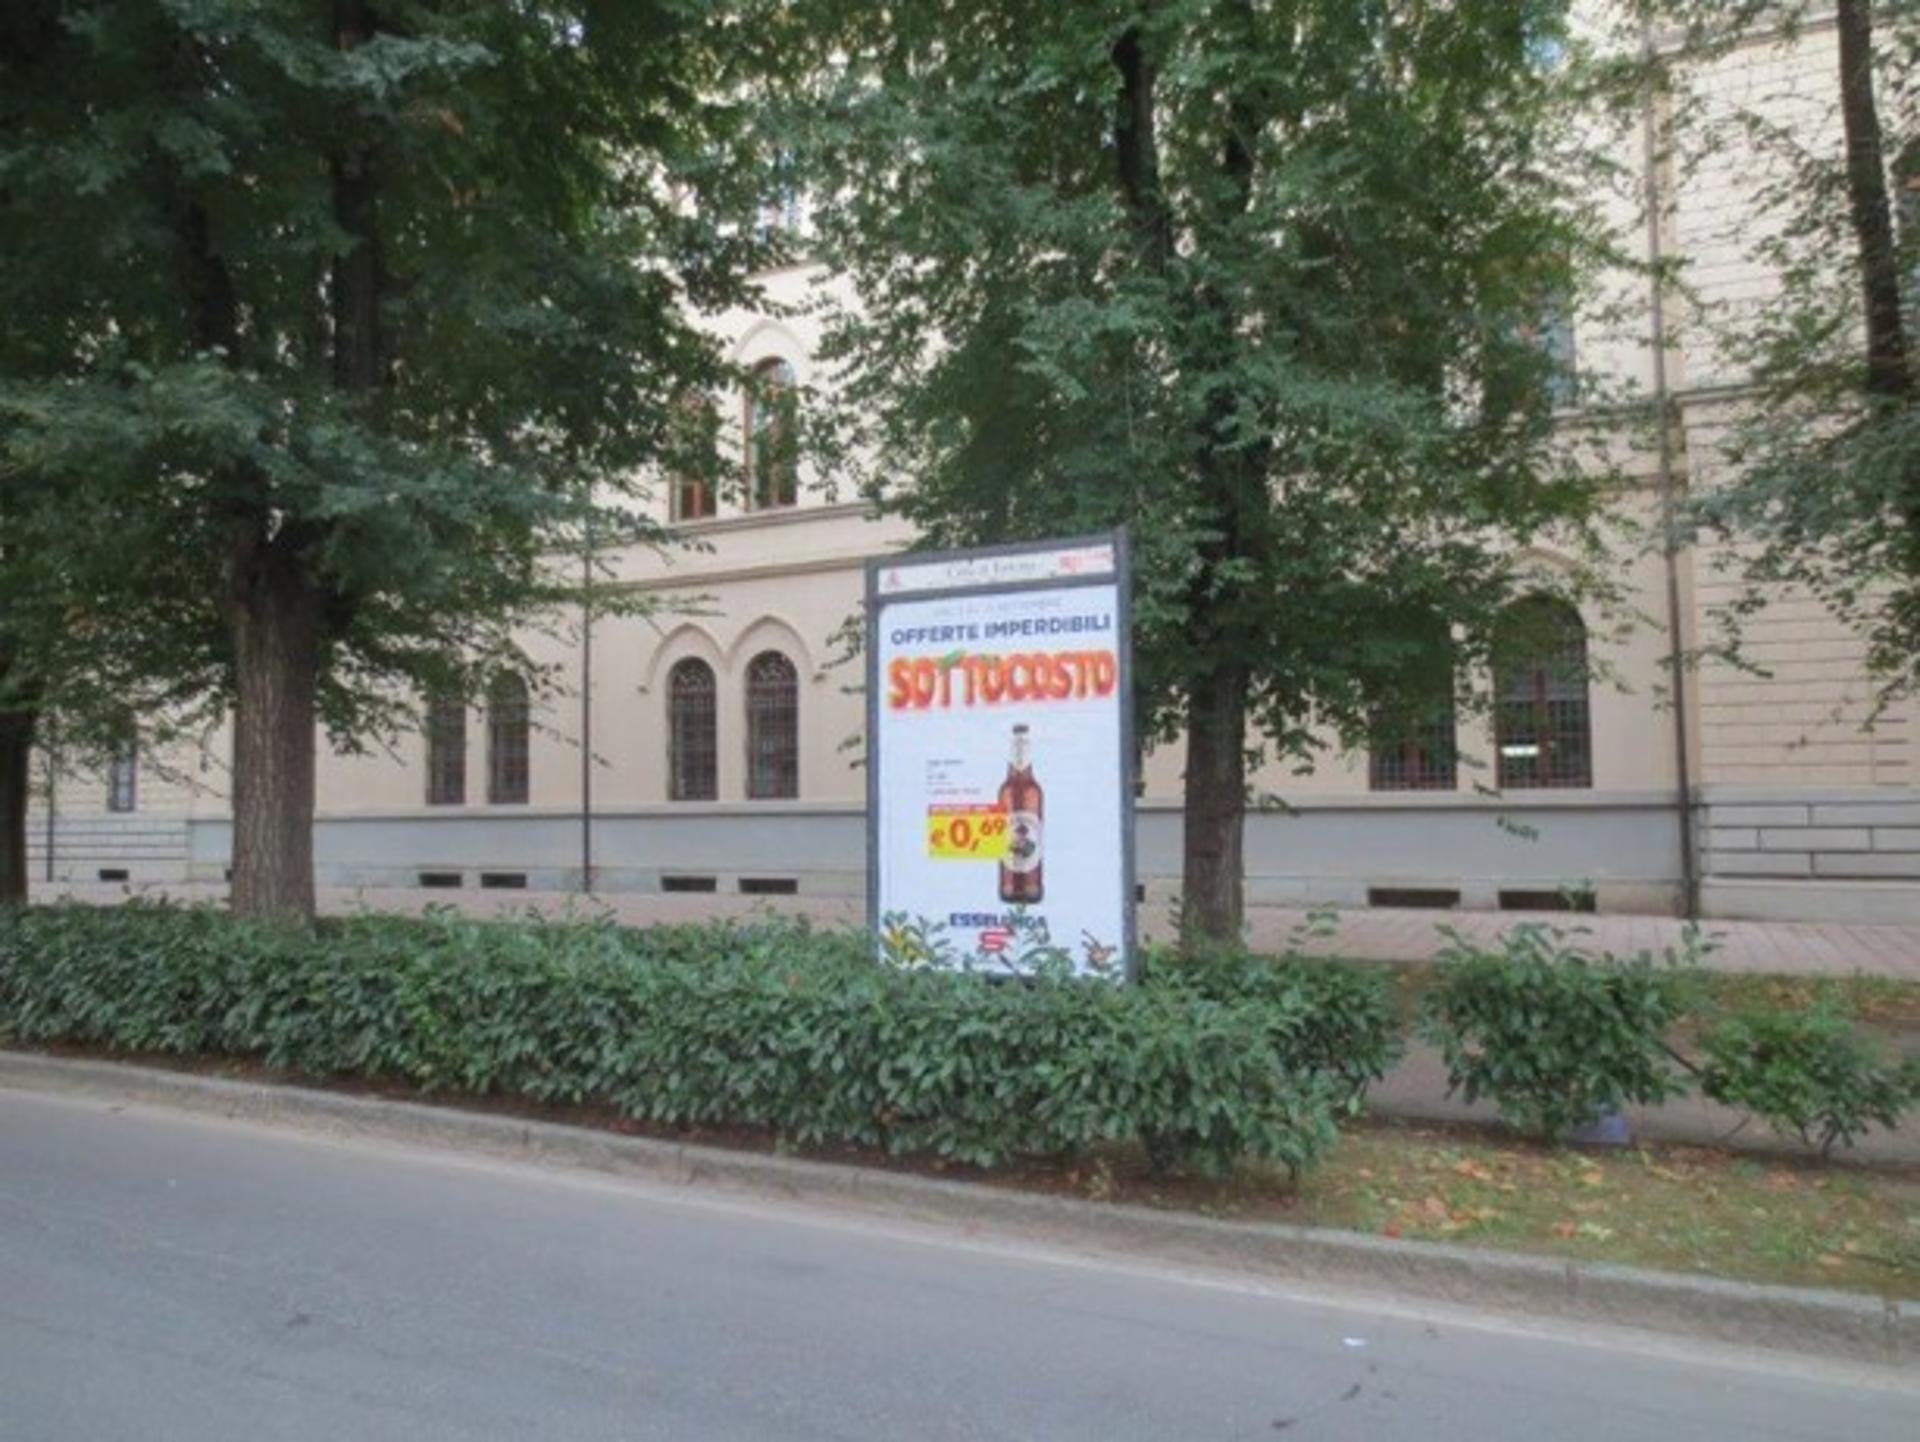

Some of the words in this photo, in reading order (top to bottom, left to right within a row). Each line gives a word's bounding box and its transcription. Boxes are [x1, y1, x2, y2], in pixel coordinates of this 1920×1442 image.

[891, 622, 980, 645] OFFERTE
[984, 614, 1111, 639] IMPERDIBILI
[888, 650, 1118, 710] SOTTOCOSTO
[950, 912, 1046, 928] ESSELGA
